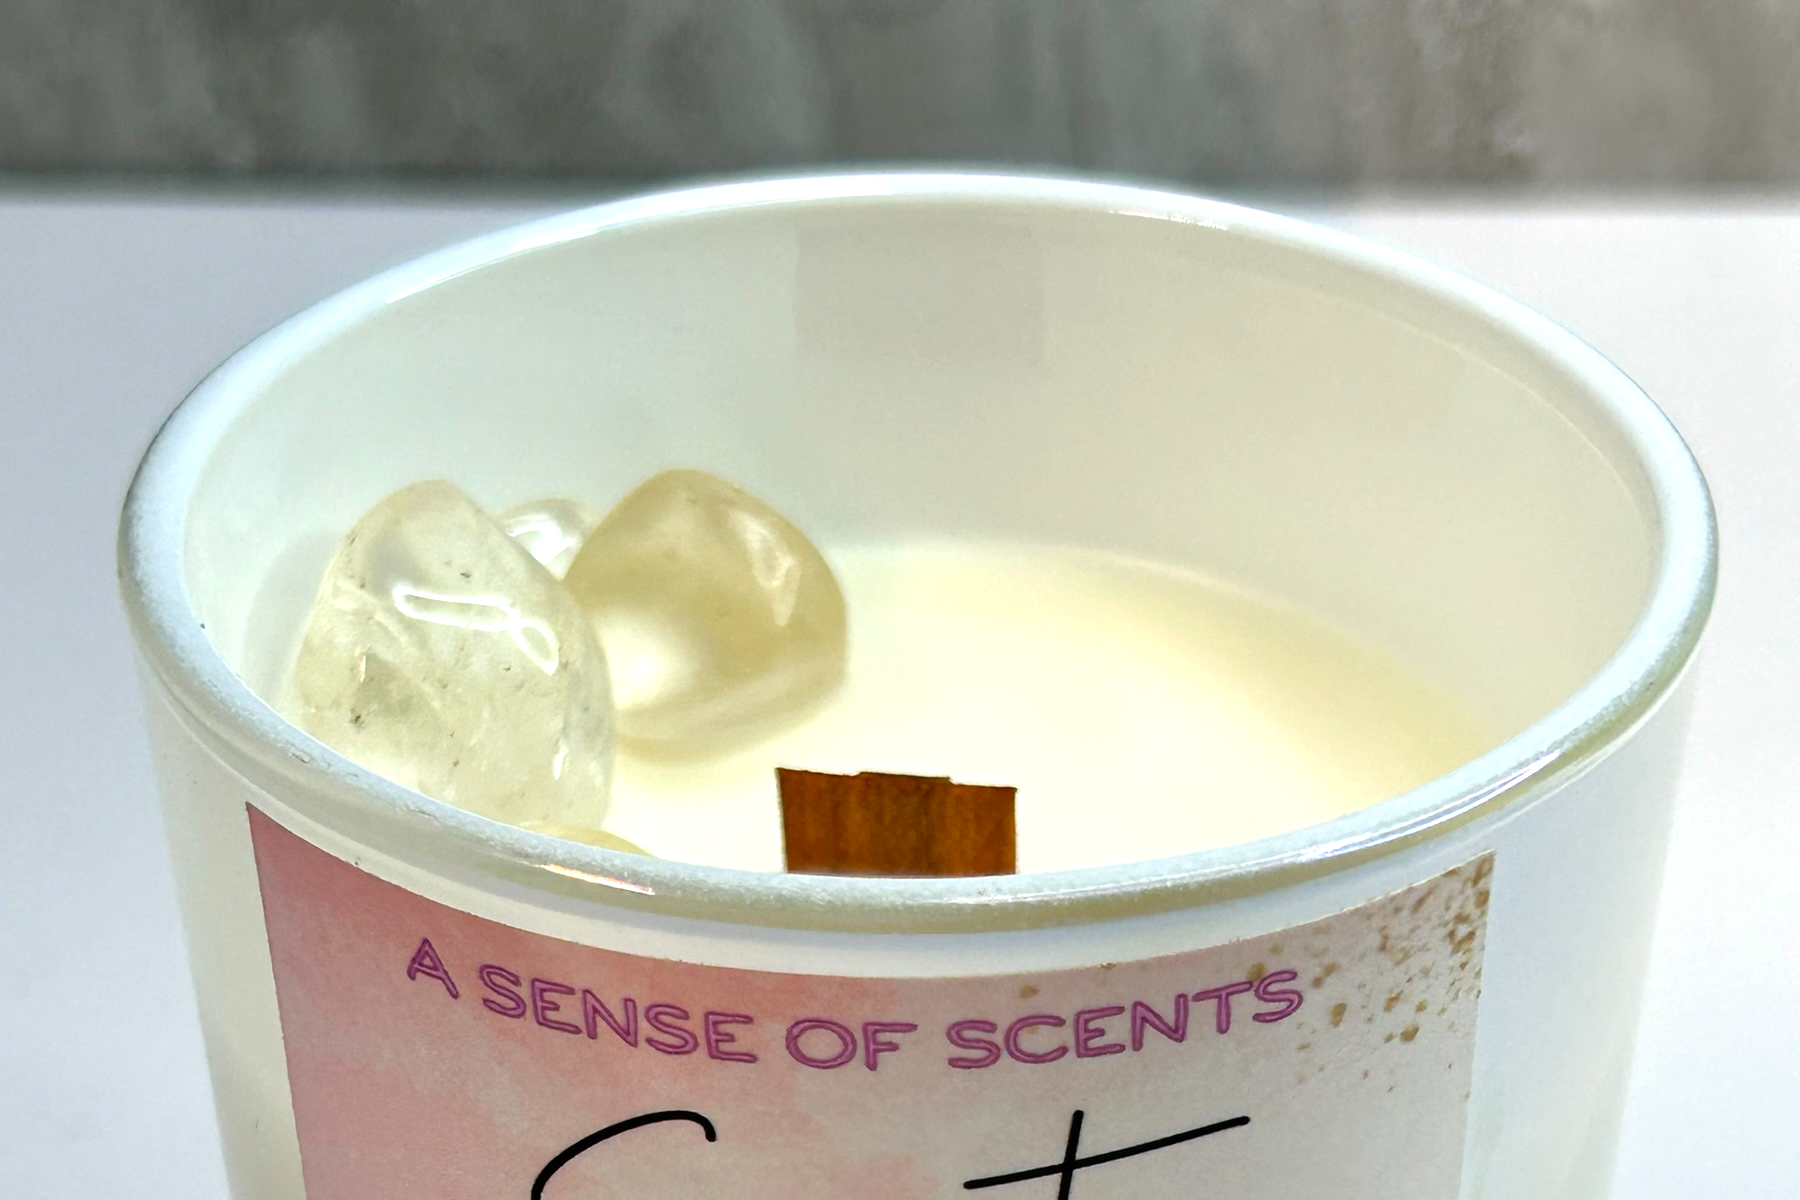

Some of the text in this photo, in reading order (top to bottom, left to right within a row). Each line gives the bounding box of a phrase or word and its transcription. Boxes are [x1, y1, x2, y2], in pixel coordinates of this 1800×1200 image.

[408, 937, 1304, 1072] A SENSE OF SCENTS
